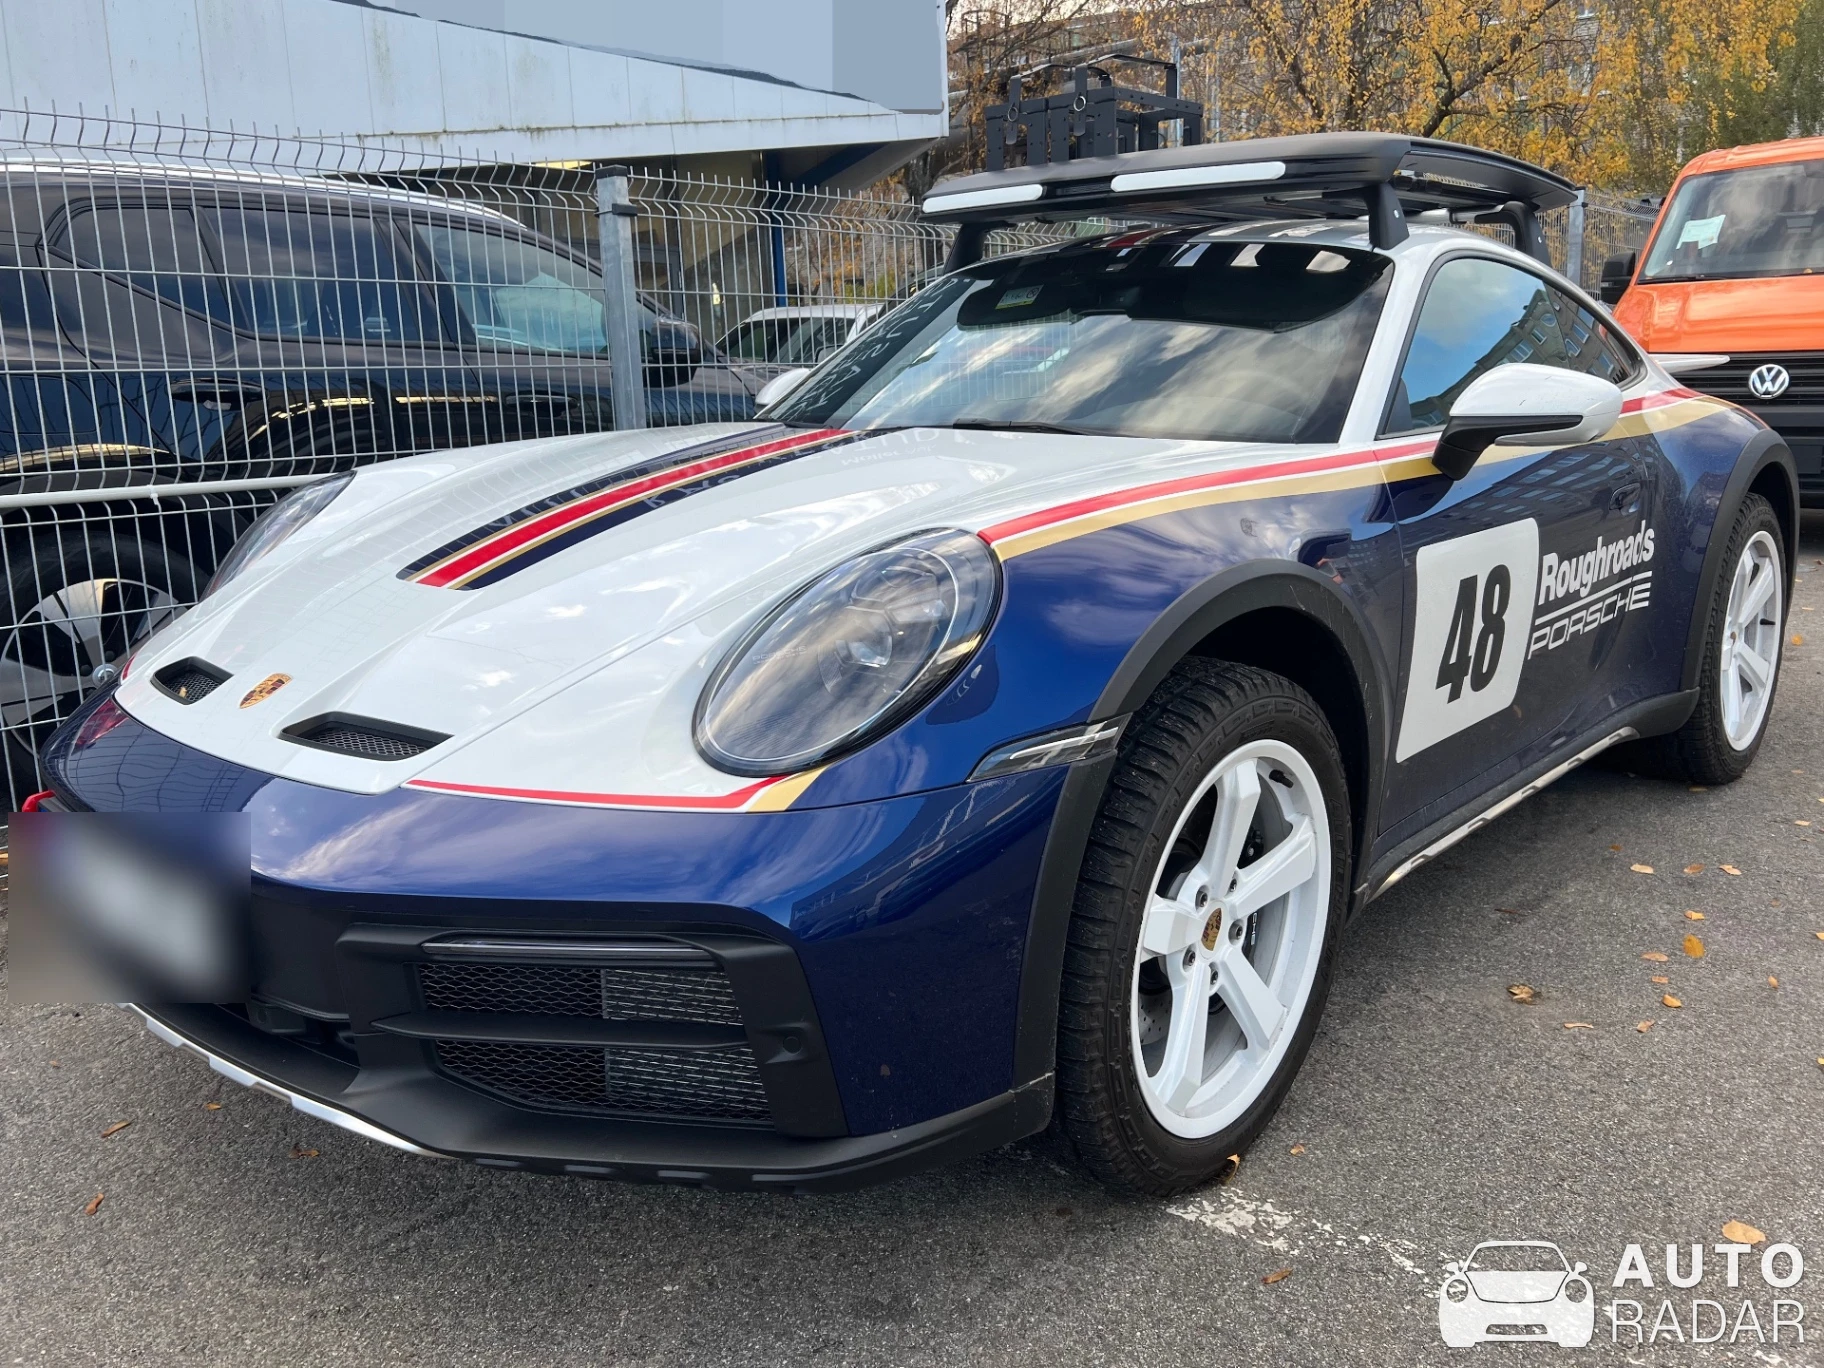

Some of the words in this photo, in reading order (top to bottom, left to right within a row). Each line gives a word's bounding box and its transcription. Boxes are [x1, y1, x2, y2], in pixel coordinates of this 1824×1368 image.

[1538, 520, 1655, 606] Roughroads
[1435, 564, 1511, 704] 48
[1528, 582, 1652, 660] PORSCHE
